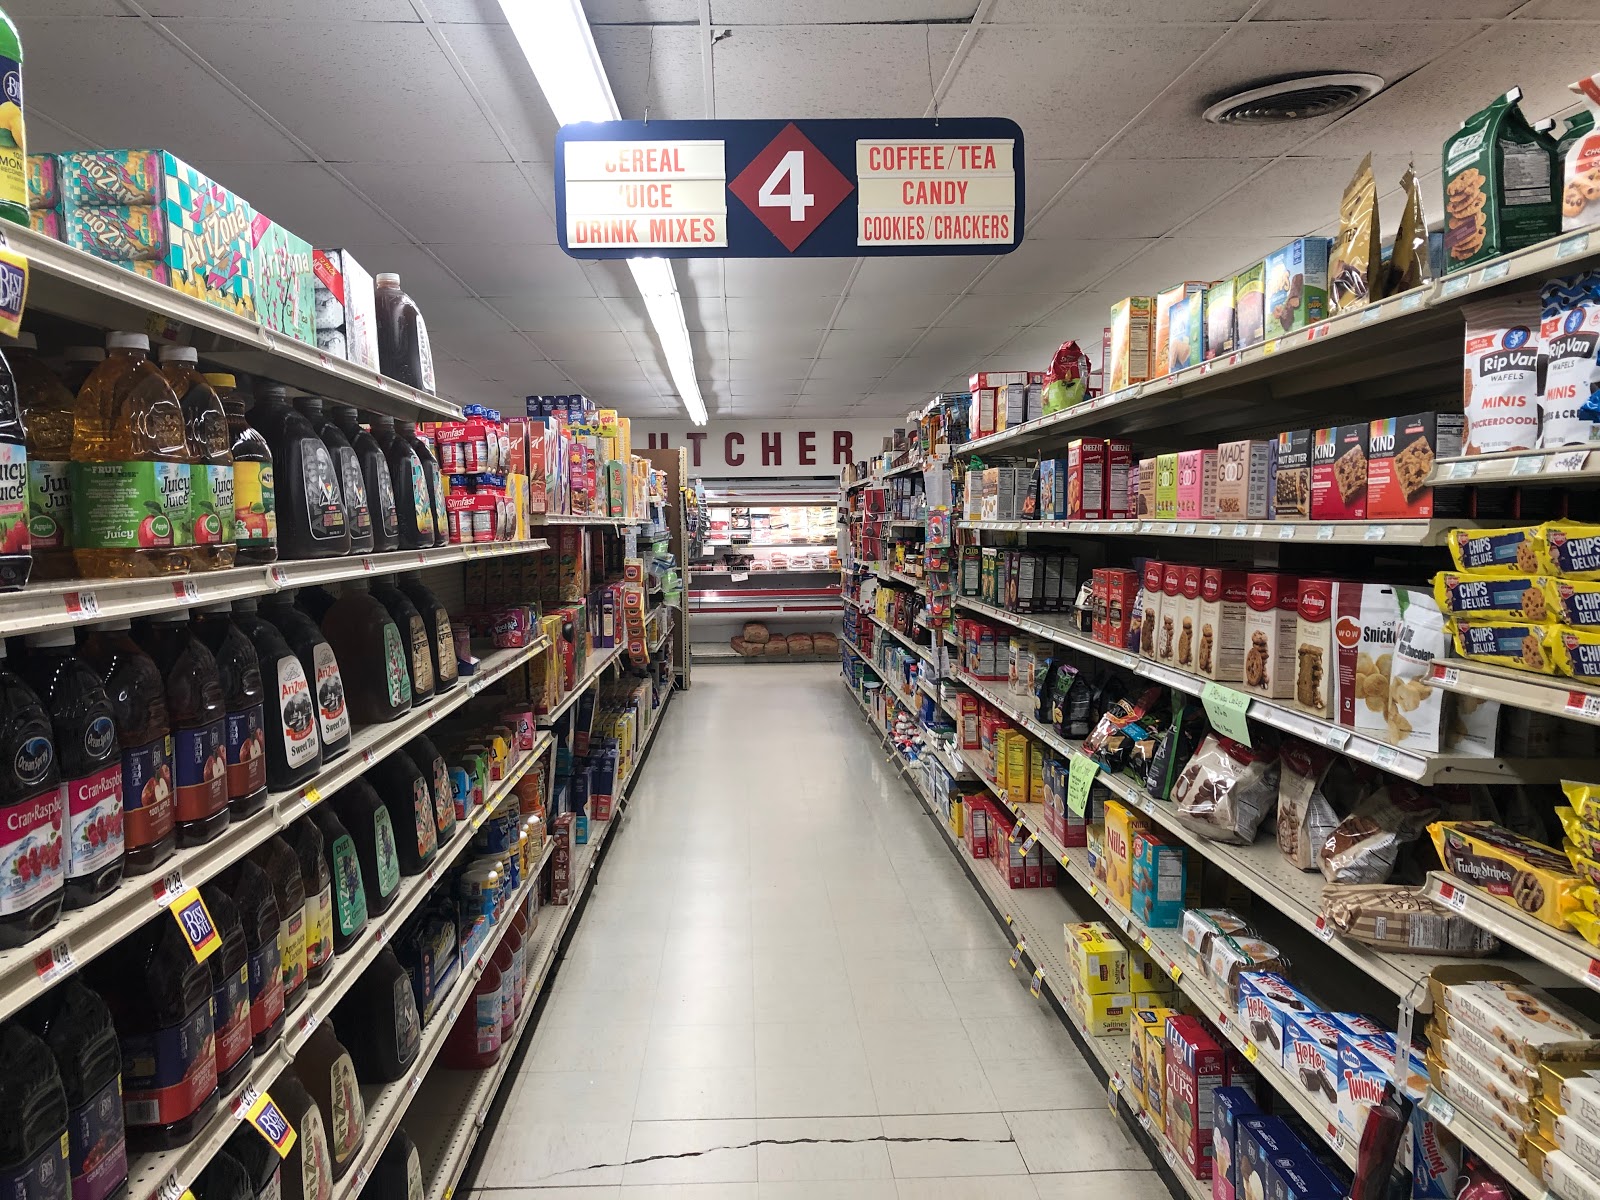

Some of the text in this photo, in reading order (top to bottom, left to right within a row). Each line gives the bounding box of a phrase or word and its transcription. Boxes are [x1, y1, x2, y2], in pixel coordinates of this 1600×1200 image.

[869, 145, 997, 171] COFFEE/TEA
[758, 150, 815, 222] 4
[902, 181, 969, 206] CANDY
[618, 183, 672, 208] UICE
[575, 218, 716, 244] DRINK MIXES
[863, 214, 1010, 241] COOKIES/CRACKERS
[183, 203, 248, 285] AriZona
[1565, 338, 1590, 355] Van
[1483, 352, 1538, 373] Rip Van
[1552, 360, 1575, 371] WAFELS
[1490, 372, 1525, 382] WAFELS
[1481, 395, 1527, 410] MINIS
[1314, 443, 1336, 459] KIND
[1369, 434, 1395, 453] KIND
[1218, 443, 1245, 462] MADE
[1278, 452, 1307, 464] NUT BUTTER
[1158, 456, 1174, 471] MADE
[1179, 453, 1198, 469] MADE
[1157, 471, 1174, 487] GOOD
[1178, 469, 1197, 486] GOOD
[1218, 463, 1244, 482] GOOD
[160, 476, 191, 495] Juicy
[163, 494, 189, 509] Juice
[104, 528, 135, 540] Juicy
[1468, 537, 1492, 556] CHIPS
[1470, 553, 1494, 567] DELUXE
[1146, 571, 1159, 583] Archway
[1165, 574, 1178, 587] Archway
[1185, 577, 1197, 590] Archway
[1204, 579, 1218, 592] Archway
[1250, 586, 1272, 600] Archway
[1459, 582, 1488, 599] CHIPS
[1302, 594, 1326, 609] Archway
[1461, 596, 1491, 610] DELUXE
[1338, 629, 1358, 638] WOW
[1470, 627, 1494, 643] CHIPS
[1472, 641, 1497, 654] DELUXE
[325, 721, 340, 735] Sweet
[291, 742, 308, 757] Sweet
[18, 755, 35, 772] Ocean
[335, 838, 350, 855] DIET
[1107, 826, 1127, 860] Nilla
[1455, 857, 1512, 881] Fudge Stripes
[183, 905, 208, 942] BEST
[199, 919, 212, 936] YET
[1102, 1020, 1128, 1029] Saltines
[1178, 1068, 1193, 1084] CREAM
[1198, 1063, 1221, 1074] CUPS
[1165, 1063, 1194, 1105] CUPS
[262, 1106, 284, 1141] BEST
[274, 1119, 287, 1135] YET
[1429, 1121, 1446, 1181] Twinkies
